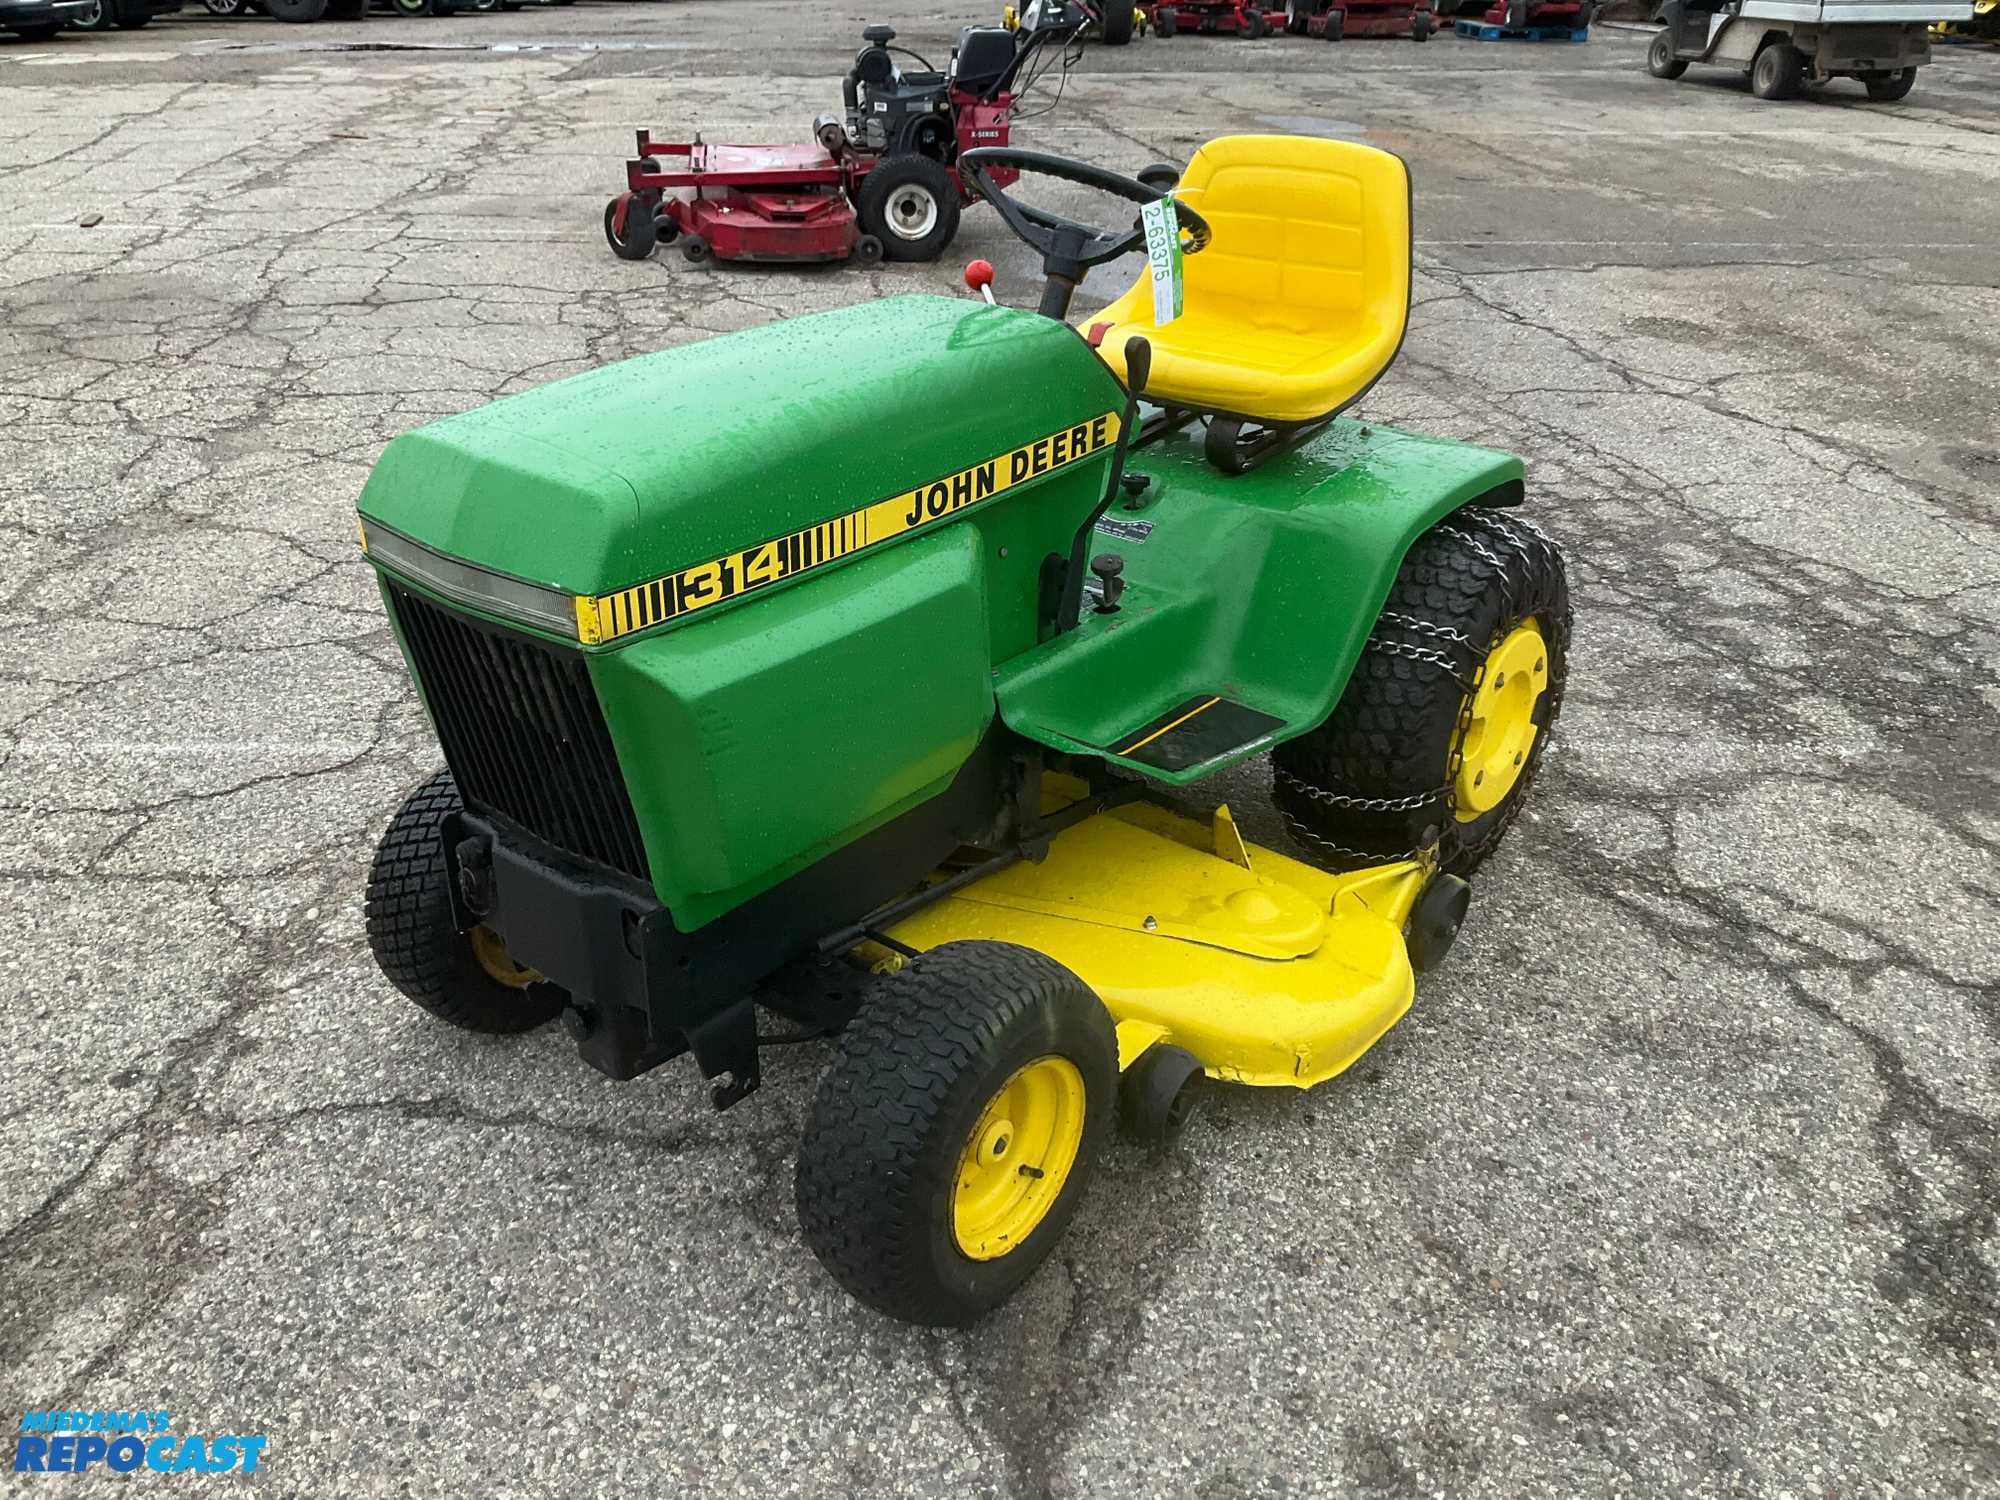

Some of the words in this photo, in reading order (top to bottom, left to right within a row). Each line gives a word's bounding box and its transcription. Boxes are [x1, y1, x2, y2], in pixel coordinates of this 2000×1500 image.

[1144, 206, 1170, 282] 2-63375
[683, 541, 783, 609] 314
[906, 461, 995, 526] JOHN
[1011, 416, 1107, 484] DEERE
